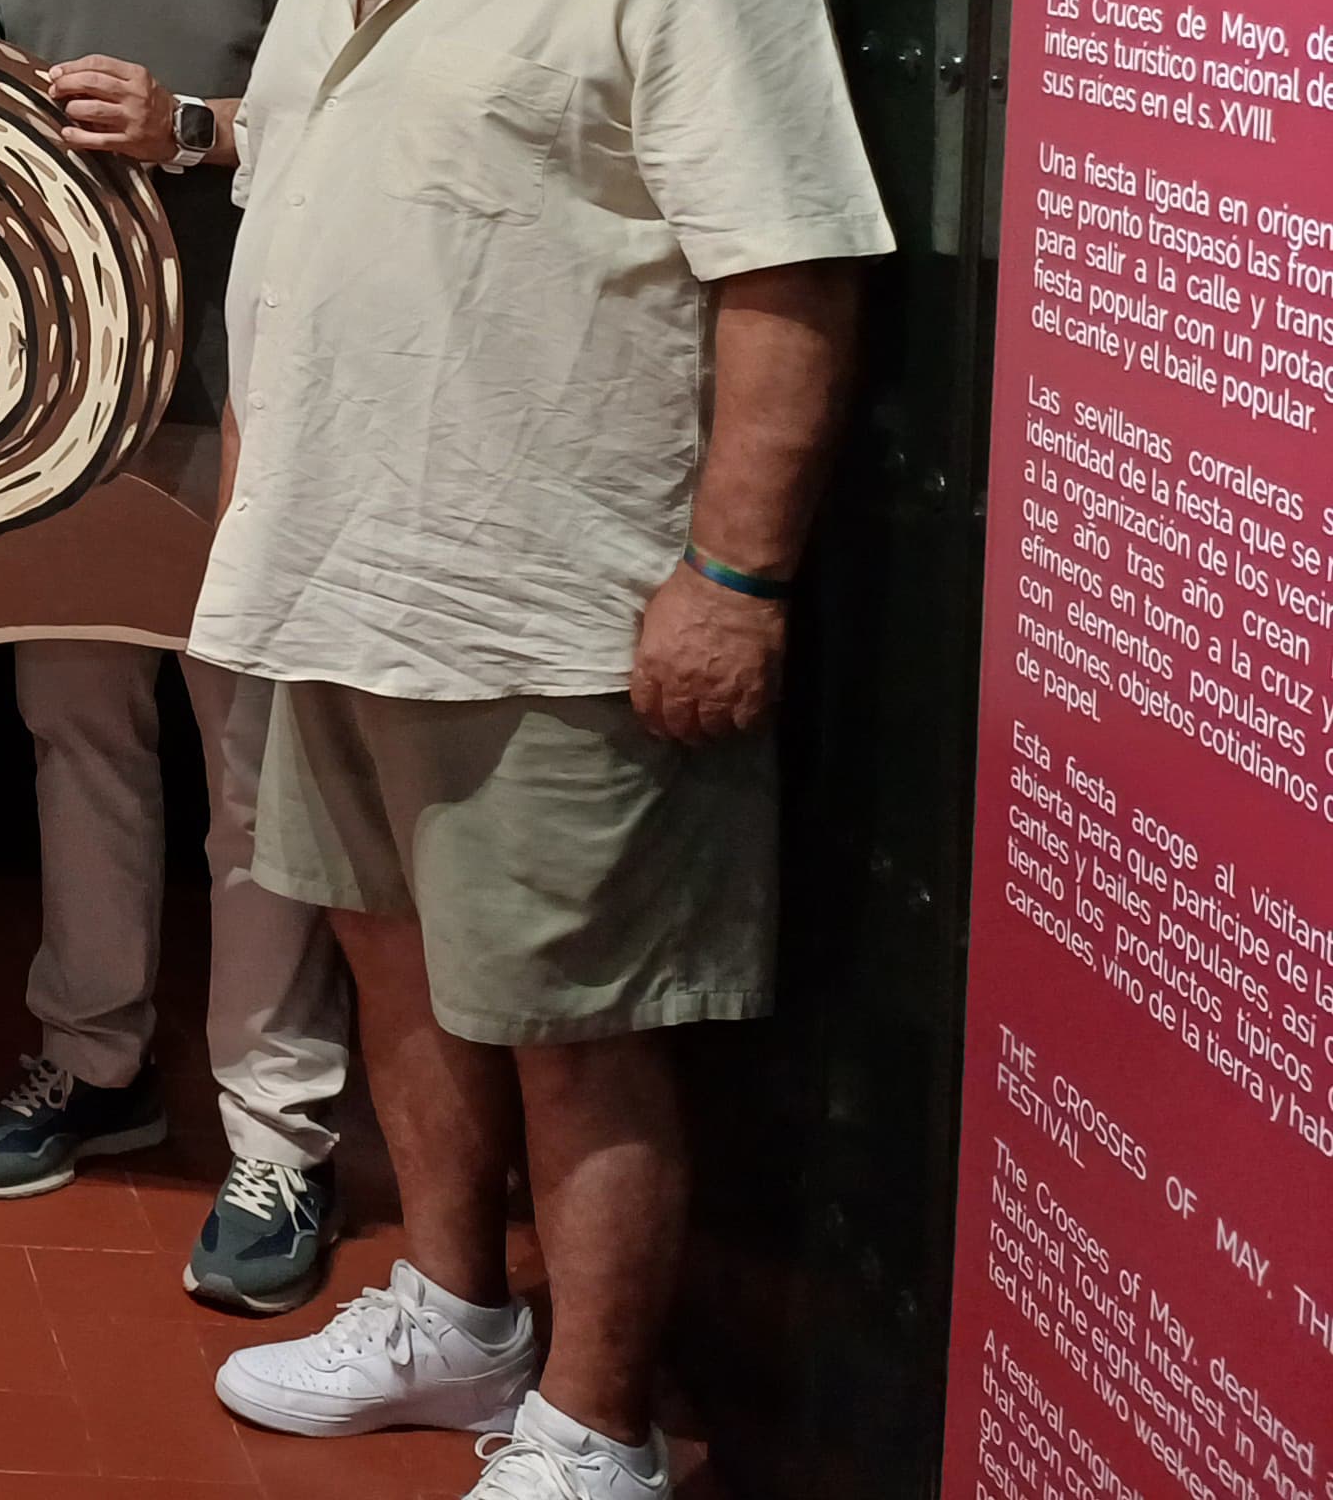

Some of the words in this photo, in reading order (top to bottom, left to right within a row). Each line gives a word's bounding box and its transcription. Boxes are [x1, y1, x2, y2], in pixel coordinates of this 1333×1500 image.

[1045, 23, 1108, 66] interés
[1114, 36, 1196, 82] turístico
[1203, 58, 1300, 103] nacional
[1176, 5, 1206, 41] de
[1042, 68, 1074, 98] sus
[1078, 74, 1137, 113] raíces
[1141, 90, 1168, 120] en
[1173, 92, 1194, 126] el
[1198, 102, 1214, 130] s.
[1219, 99, 1277, 143] XVIII.
[1039, 141, 1076, 180] Una
[1084, 152, 1137, 196] fiesta
[1145, 167, 1210, 216] ligada
[1219, 195, 1248, 227] en
[1035, 225, 1076, 260] para
[1085, 240, 1127, 276] salir
[1134, 258, 1147, 284] a
[1158, 257, 1176, 293] la
[1187, 273, 1241, 313] calle
[1250, 293, 1265, 330] y
[1037, 187, 1073, 220] que
[1078, 199, 1143, 239] pronto
[1148, 213, 1241, 269] traspasó
[1248, 239, 1281, 282] las
[1033, 259, 1082, 303] fiesta
[1089, 283, 1169, 332] popular
[1174, 313, 1215, 350] con
[1223, 330, 1253, 363] un
[1032, 299, 1062, 336] del
[1064, 318, 1119, 357] cante
[1123, 337, 1136, 371] y
[1140, 340, 1160, 375] el
[1165, 345, 1217, 395] baile
[1222, 374, 1317, 433] popular.
[997, 1062, 1085, 1169] FESTIVAL
[999, 1023, 1037, 1082] THE
[1052, 1075, 1147, 1181] CROSSES
[1166, 1176, 1197, 1220] OF
